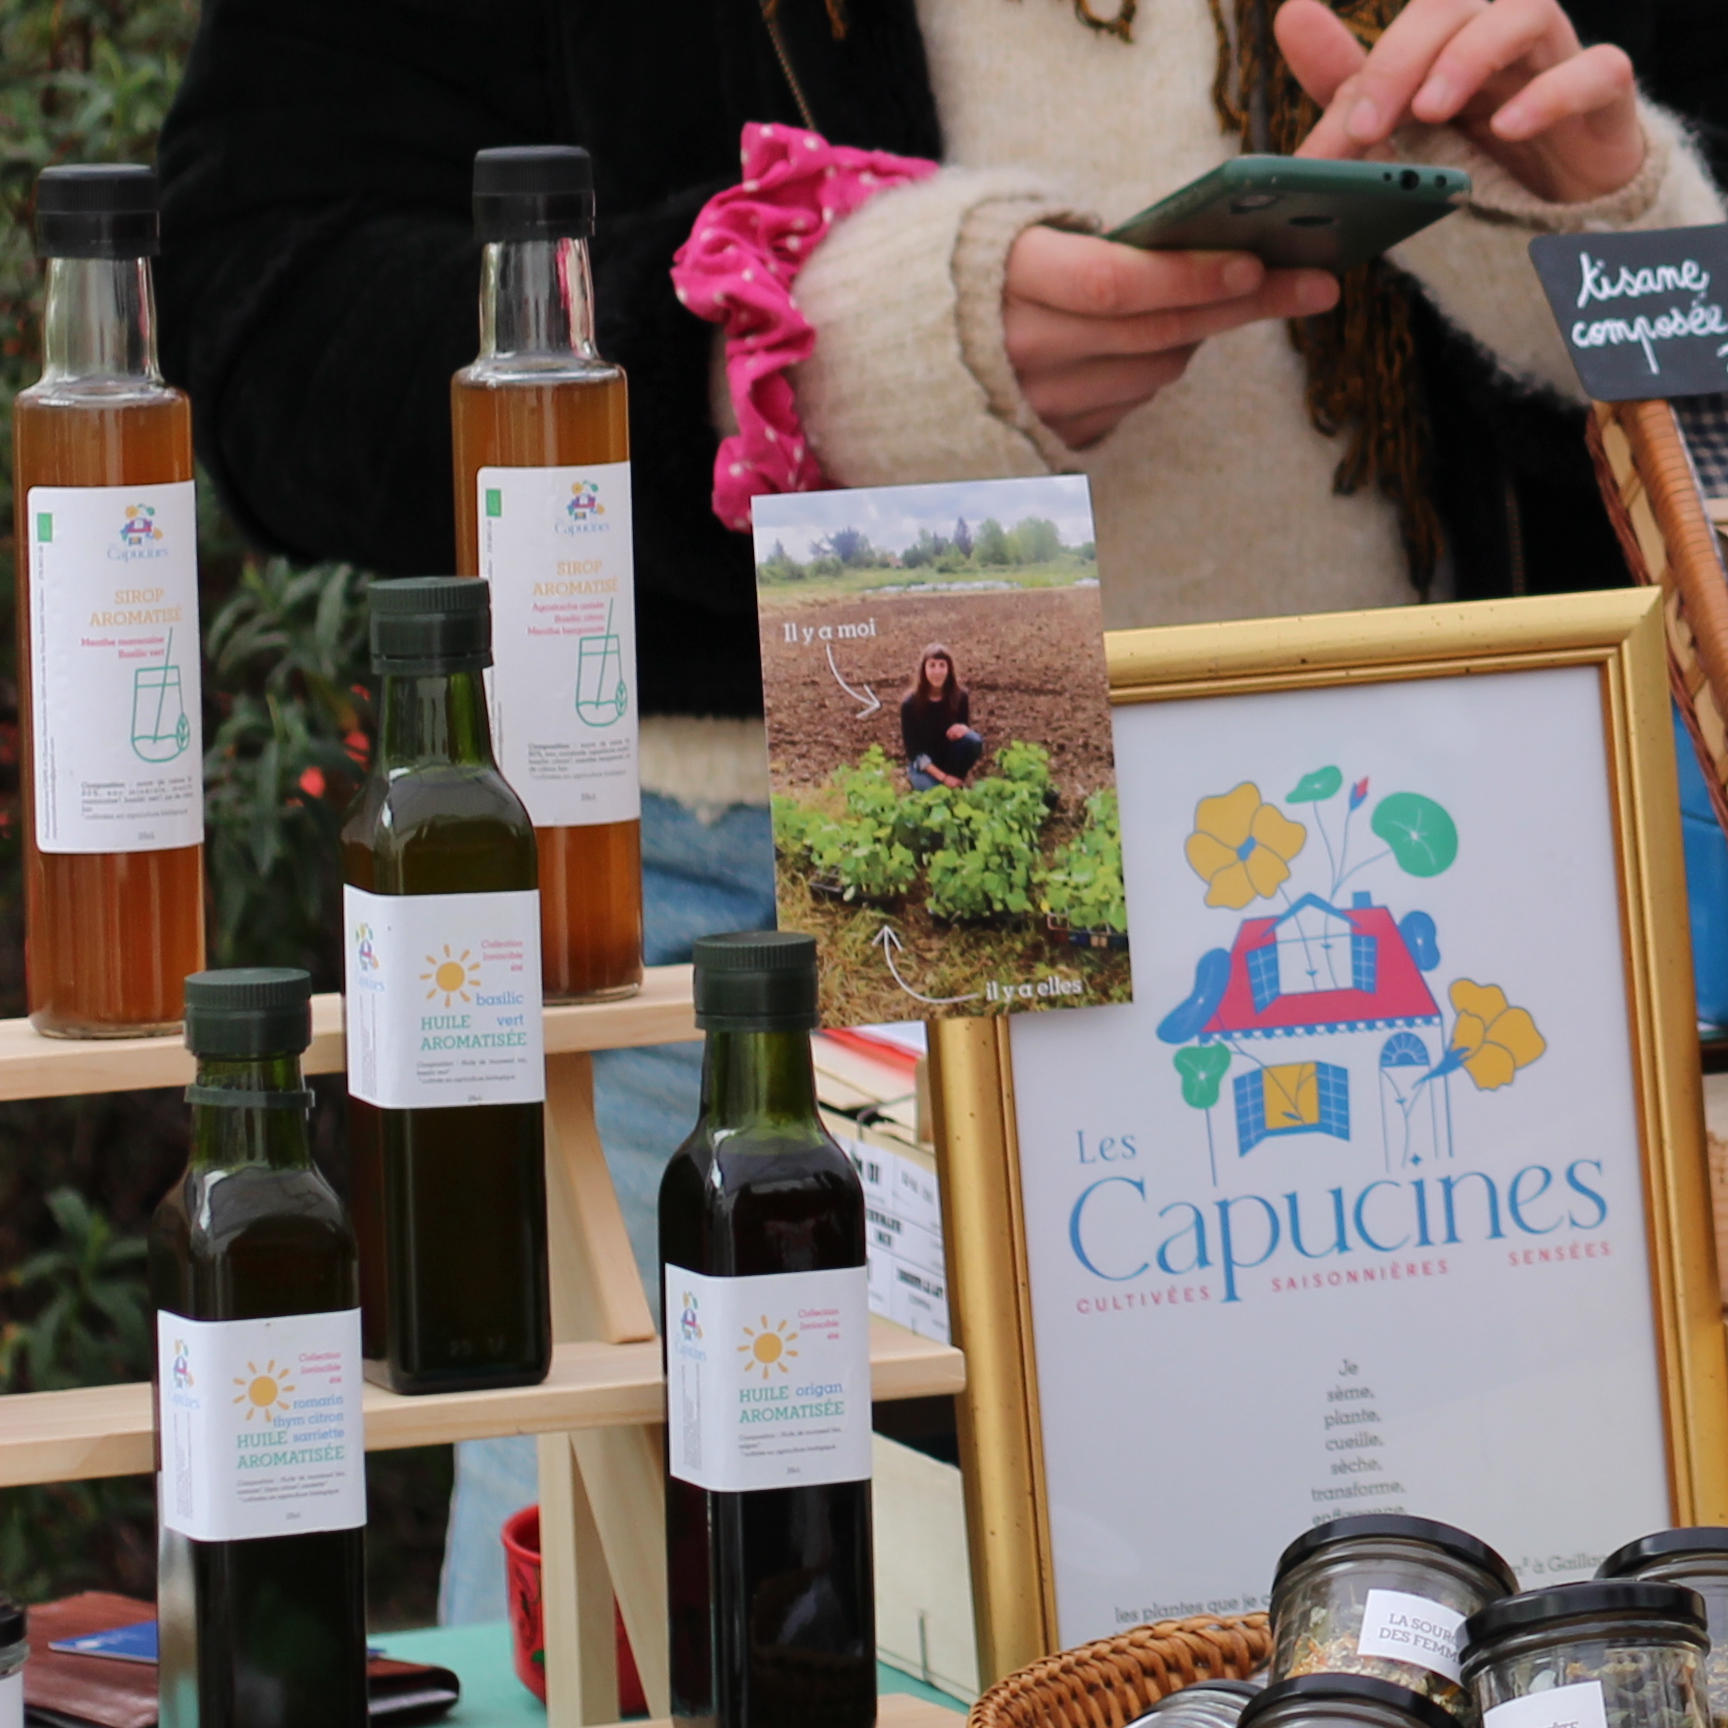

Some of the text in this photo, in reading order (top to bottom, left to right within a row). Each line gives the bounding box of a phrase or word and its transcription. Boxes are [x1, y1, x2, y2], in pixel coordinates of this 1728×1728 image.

[557, 560, 603, 576] SIROP
[114, 587, 164, 605] SIROP
[802, 626, 815, 645] y
[818, 625, 833, 640] a
[837, 617, 876, 639] moi
[476, 991, 524, 1007] basilic
[986, 975, 1083, 1004] il y a elles
[420, 1013, 524, 1031] HUILE vert
[420, 1029, 527, 1051] AROMATISÉE
[1076, 1129, 1138, 1166] Les
[1068, 1158, 1610, 1303] Capucines
[1076, 1240, 1613, 1315] CULTIVÉES SAISONNIÈRES SENSÉES
[1338, 1358, 1359, 1377] Je
[293, 1394, 345, 1410] romarin
[738, 1382, 843, 1403] HUILE origan
[273, 1411, 345, 1429] thym citron
[738, 1399, 845, 1424] AROMATISÉE
[236, 1427, 345, 1449] HUILE sarriette
[236, 1443, 346, 1470] AROMATISÉE
[1114, 1606, 1138, 1623] les
[1142, 1601, 1203, 1623] plantes
[1206, 1597, 1238, 1614] que
[1242, 1591, 1257, 1611] je
[1388, 1613, 1457, 1643] LA SOUR
[1378, 1626, 1460, 1665] DES FEMM
